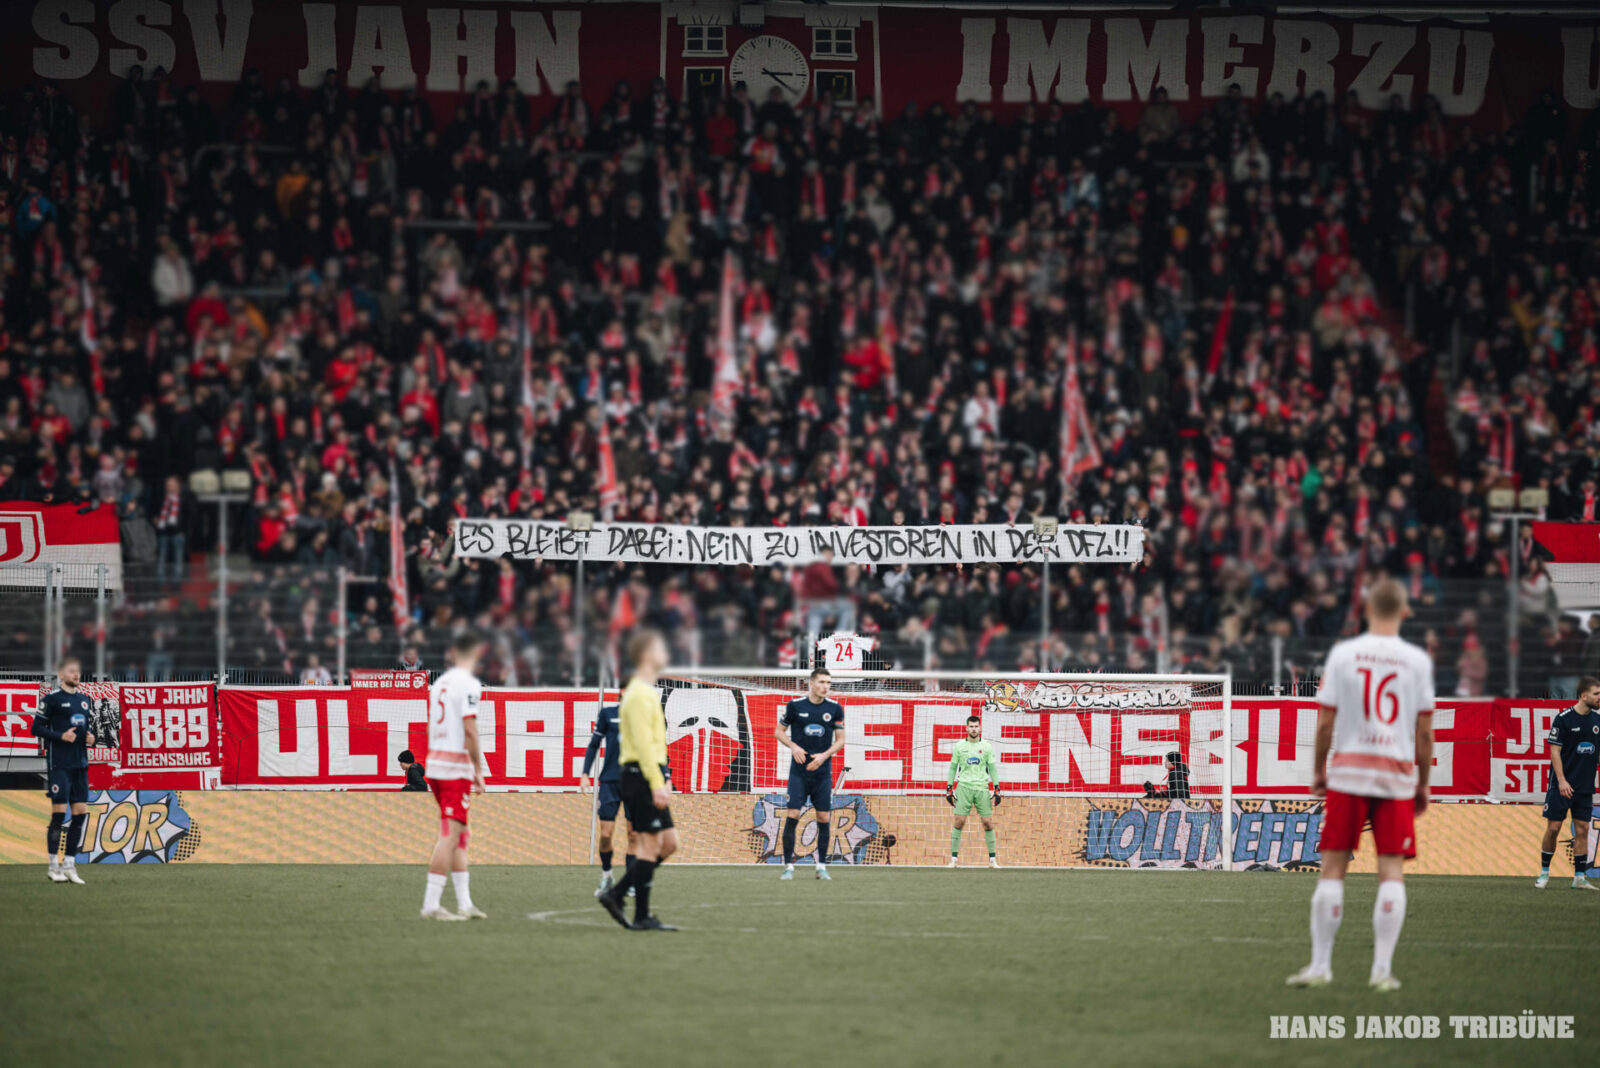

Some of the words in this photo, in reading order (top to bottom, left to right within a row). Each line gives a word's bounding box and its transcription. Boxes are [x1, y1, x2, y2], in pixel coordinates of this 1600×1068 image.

[31, 0, 254, 80] SSV
[298, 3, 582, 94] JAHN
[956, 16, 1496, 116] IMMERZU
[459, 521, 494, 553] ES
[764, 531, 799, 559] ZU
[835, 642, 853, 662] 24
[124, 687, 157, 705] SSV
[163, 687, 208, 704] JAHN
[353, 680, 378, 688] IMMER
[380, 680, 392, 688] BEI
[394, 680, 410, 688] UNS
[1357, 667, 1399, 726] 16
[126, 707, 209, 749] 1889
[127, 752, 211, 767] REGENSBURG
[82, 801, 168, 854] TOR
